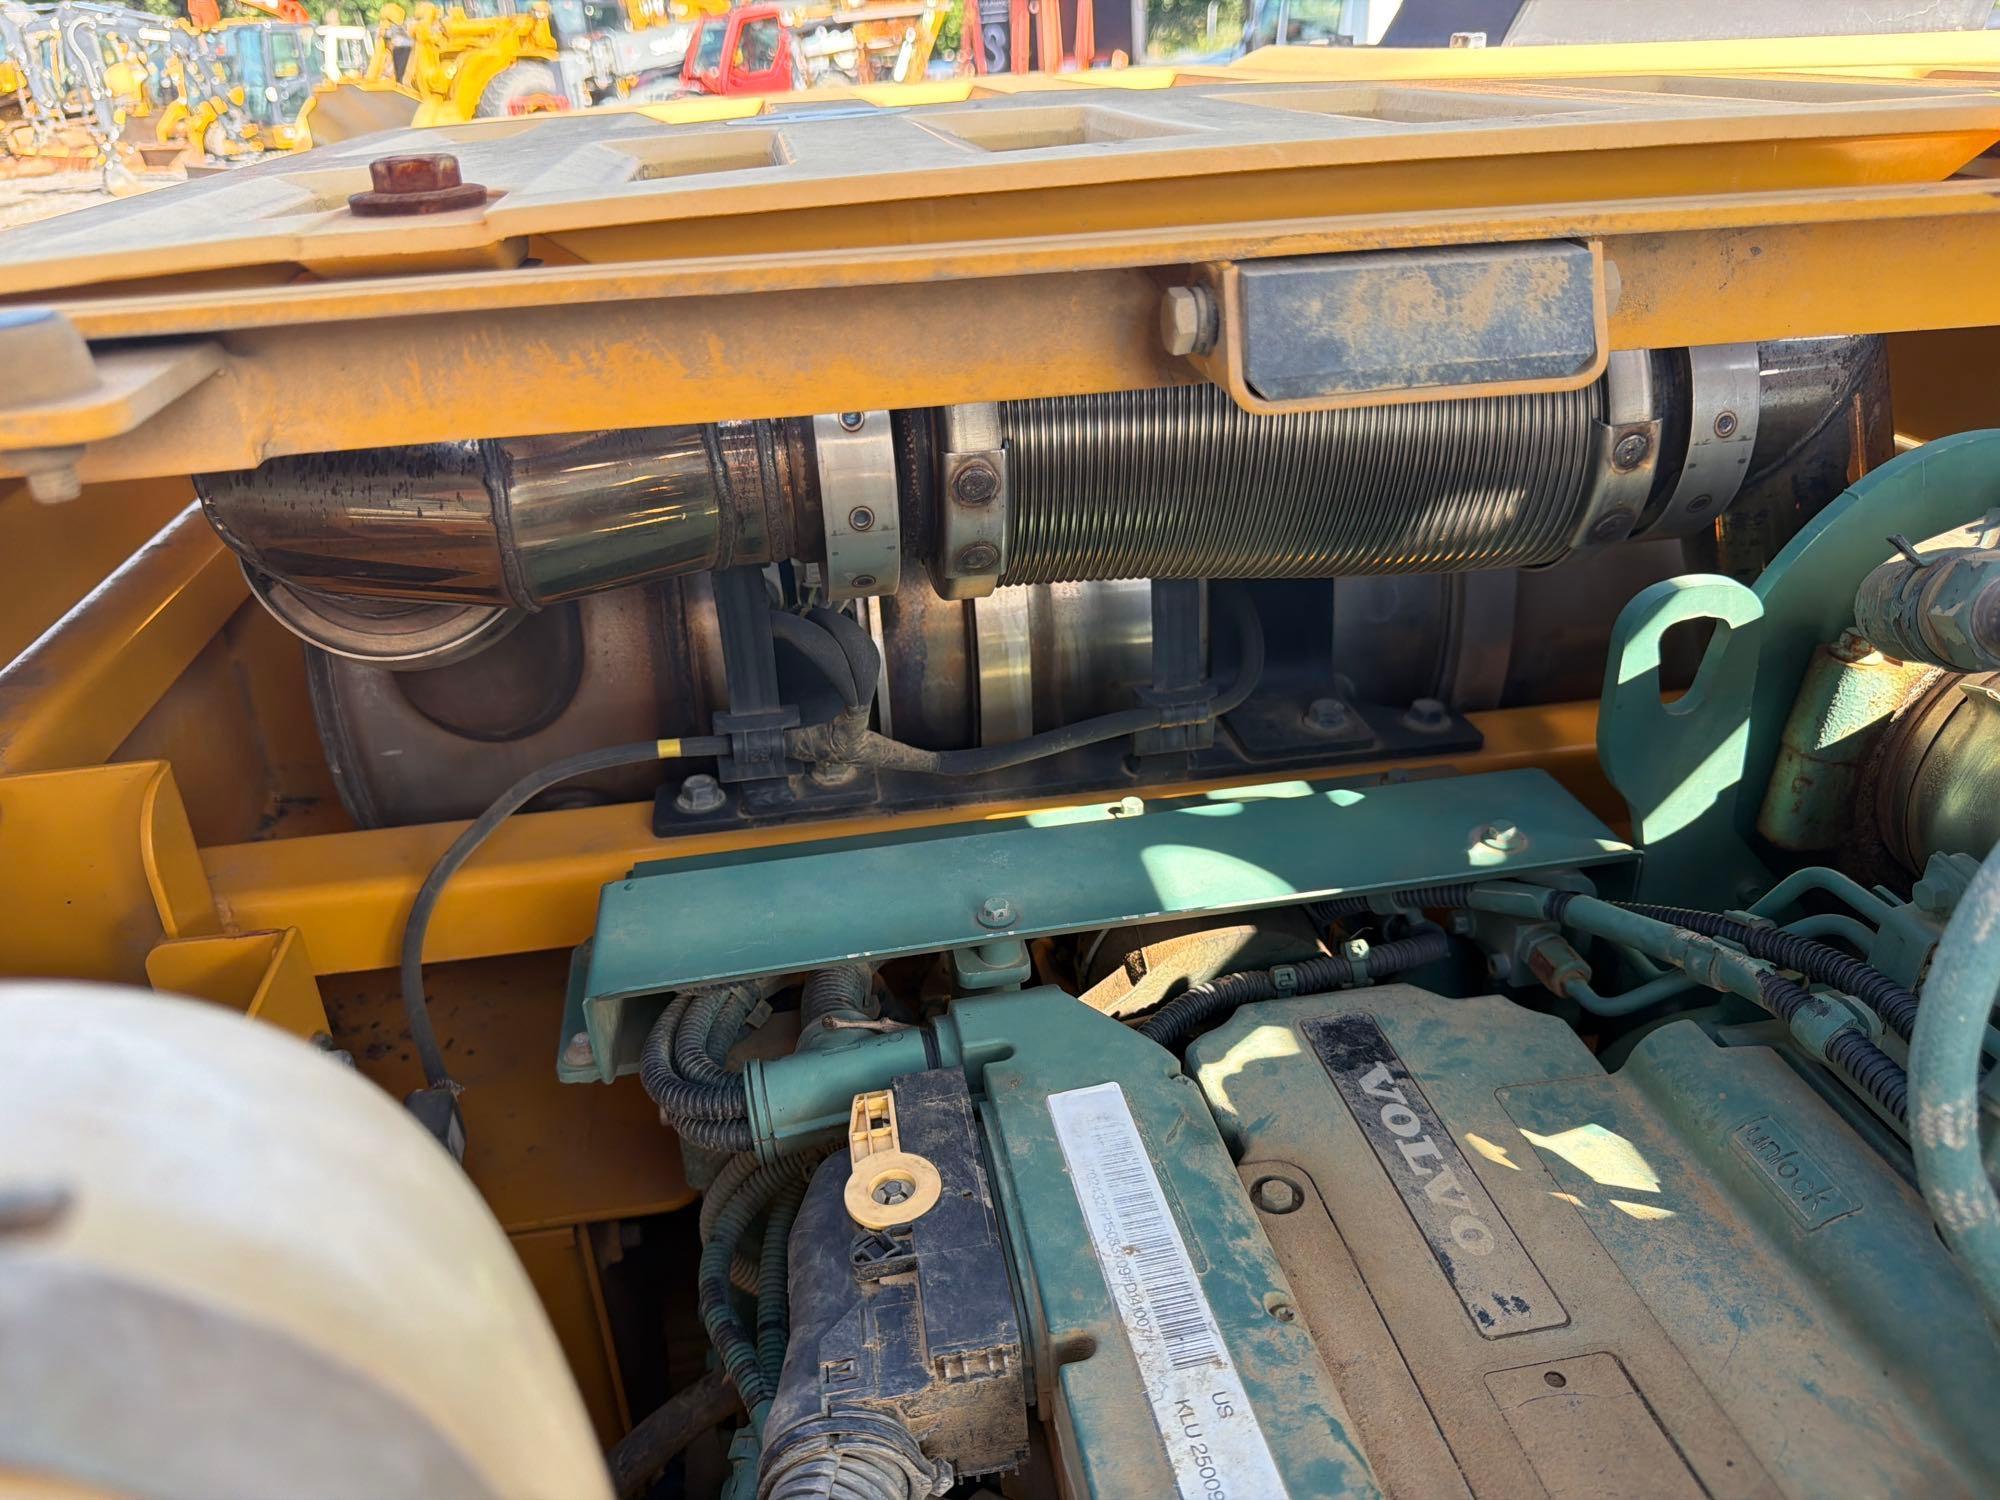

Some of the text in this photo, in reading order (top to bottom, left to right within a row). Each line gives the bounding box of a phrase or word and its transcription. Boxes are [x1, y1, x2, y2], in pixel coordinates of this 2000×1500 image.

[1358, 1060, 1494, 1256] VOLVO
[1174, 1399, 1202, 1438] KLU
[1211, 1391, 1233, 1418] US
